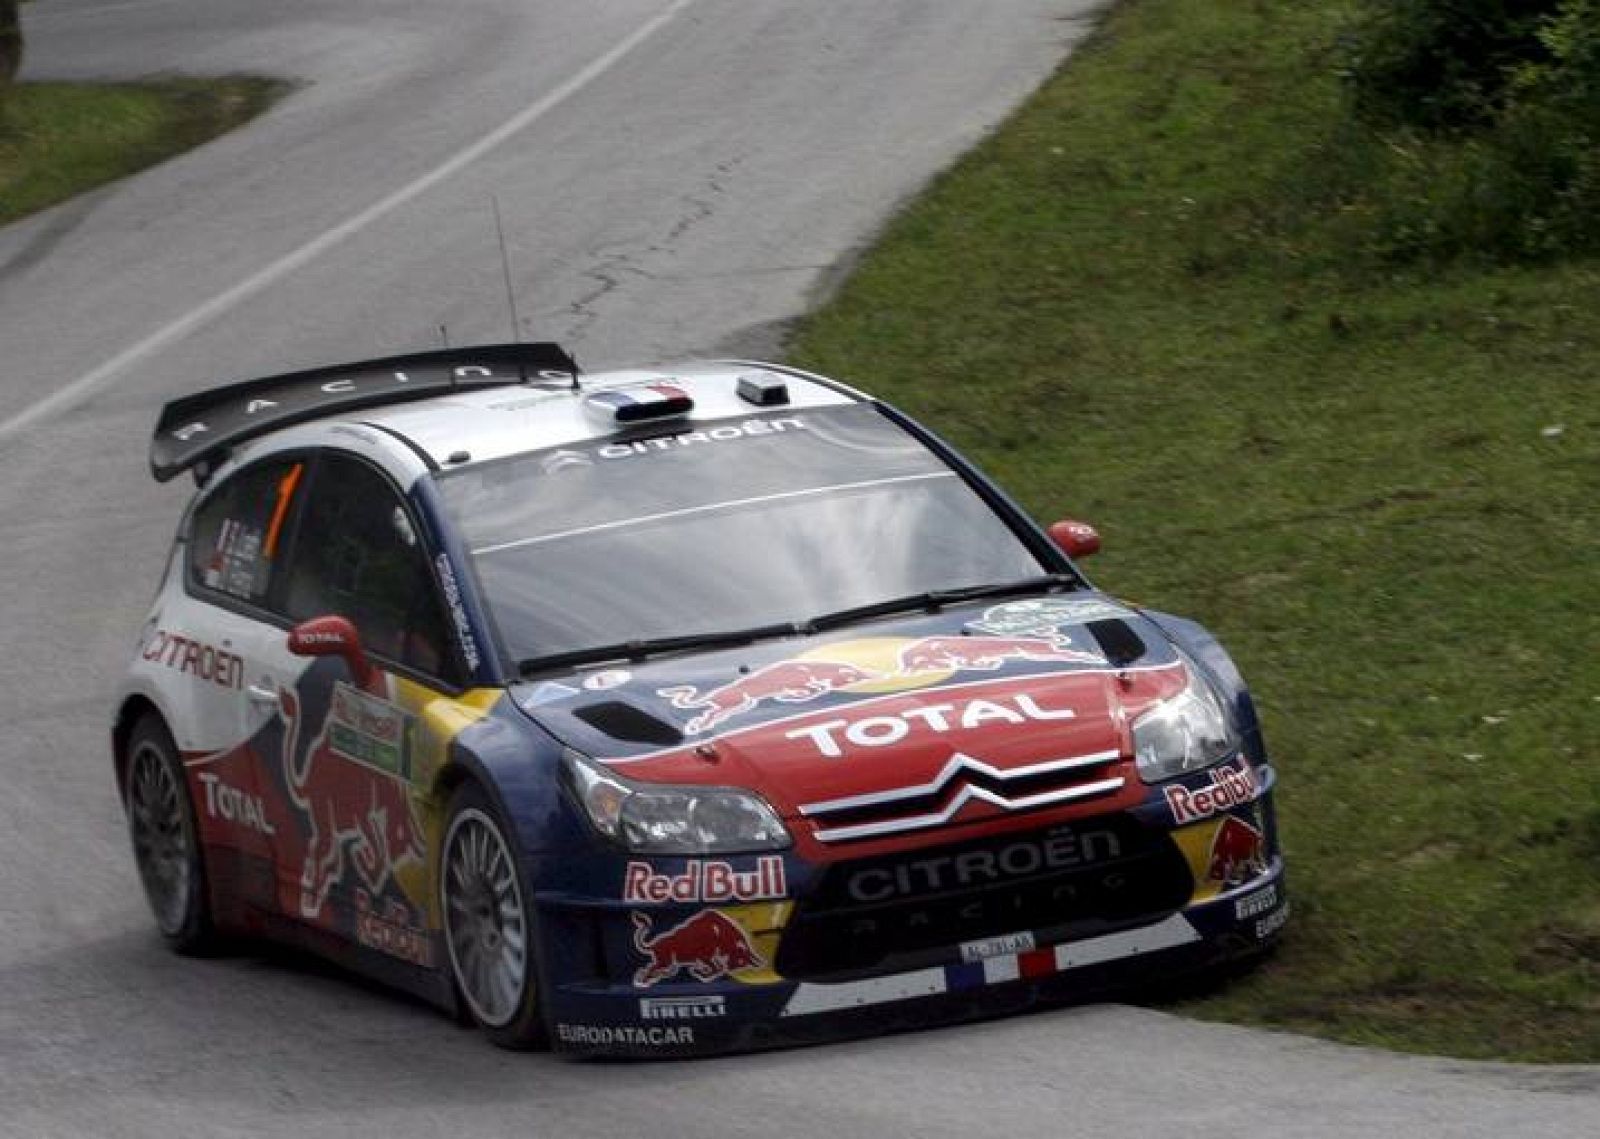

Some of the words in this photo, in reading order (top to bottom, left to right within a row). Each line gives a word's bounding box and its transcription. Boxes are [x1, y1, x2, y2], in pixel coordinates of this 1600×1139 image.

[262, 463, 304, 559] 1
[786, 694, 1077, 758] TOTAL
[196, 771, 277, 835] TOTAL
[624, 859, 699, 902] Red
[702, 855, 787, 901] Bull
[557, 1023, 695, 1045] EURODATACAR
[639, 995, 727, 1019] PIRELLI
